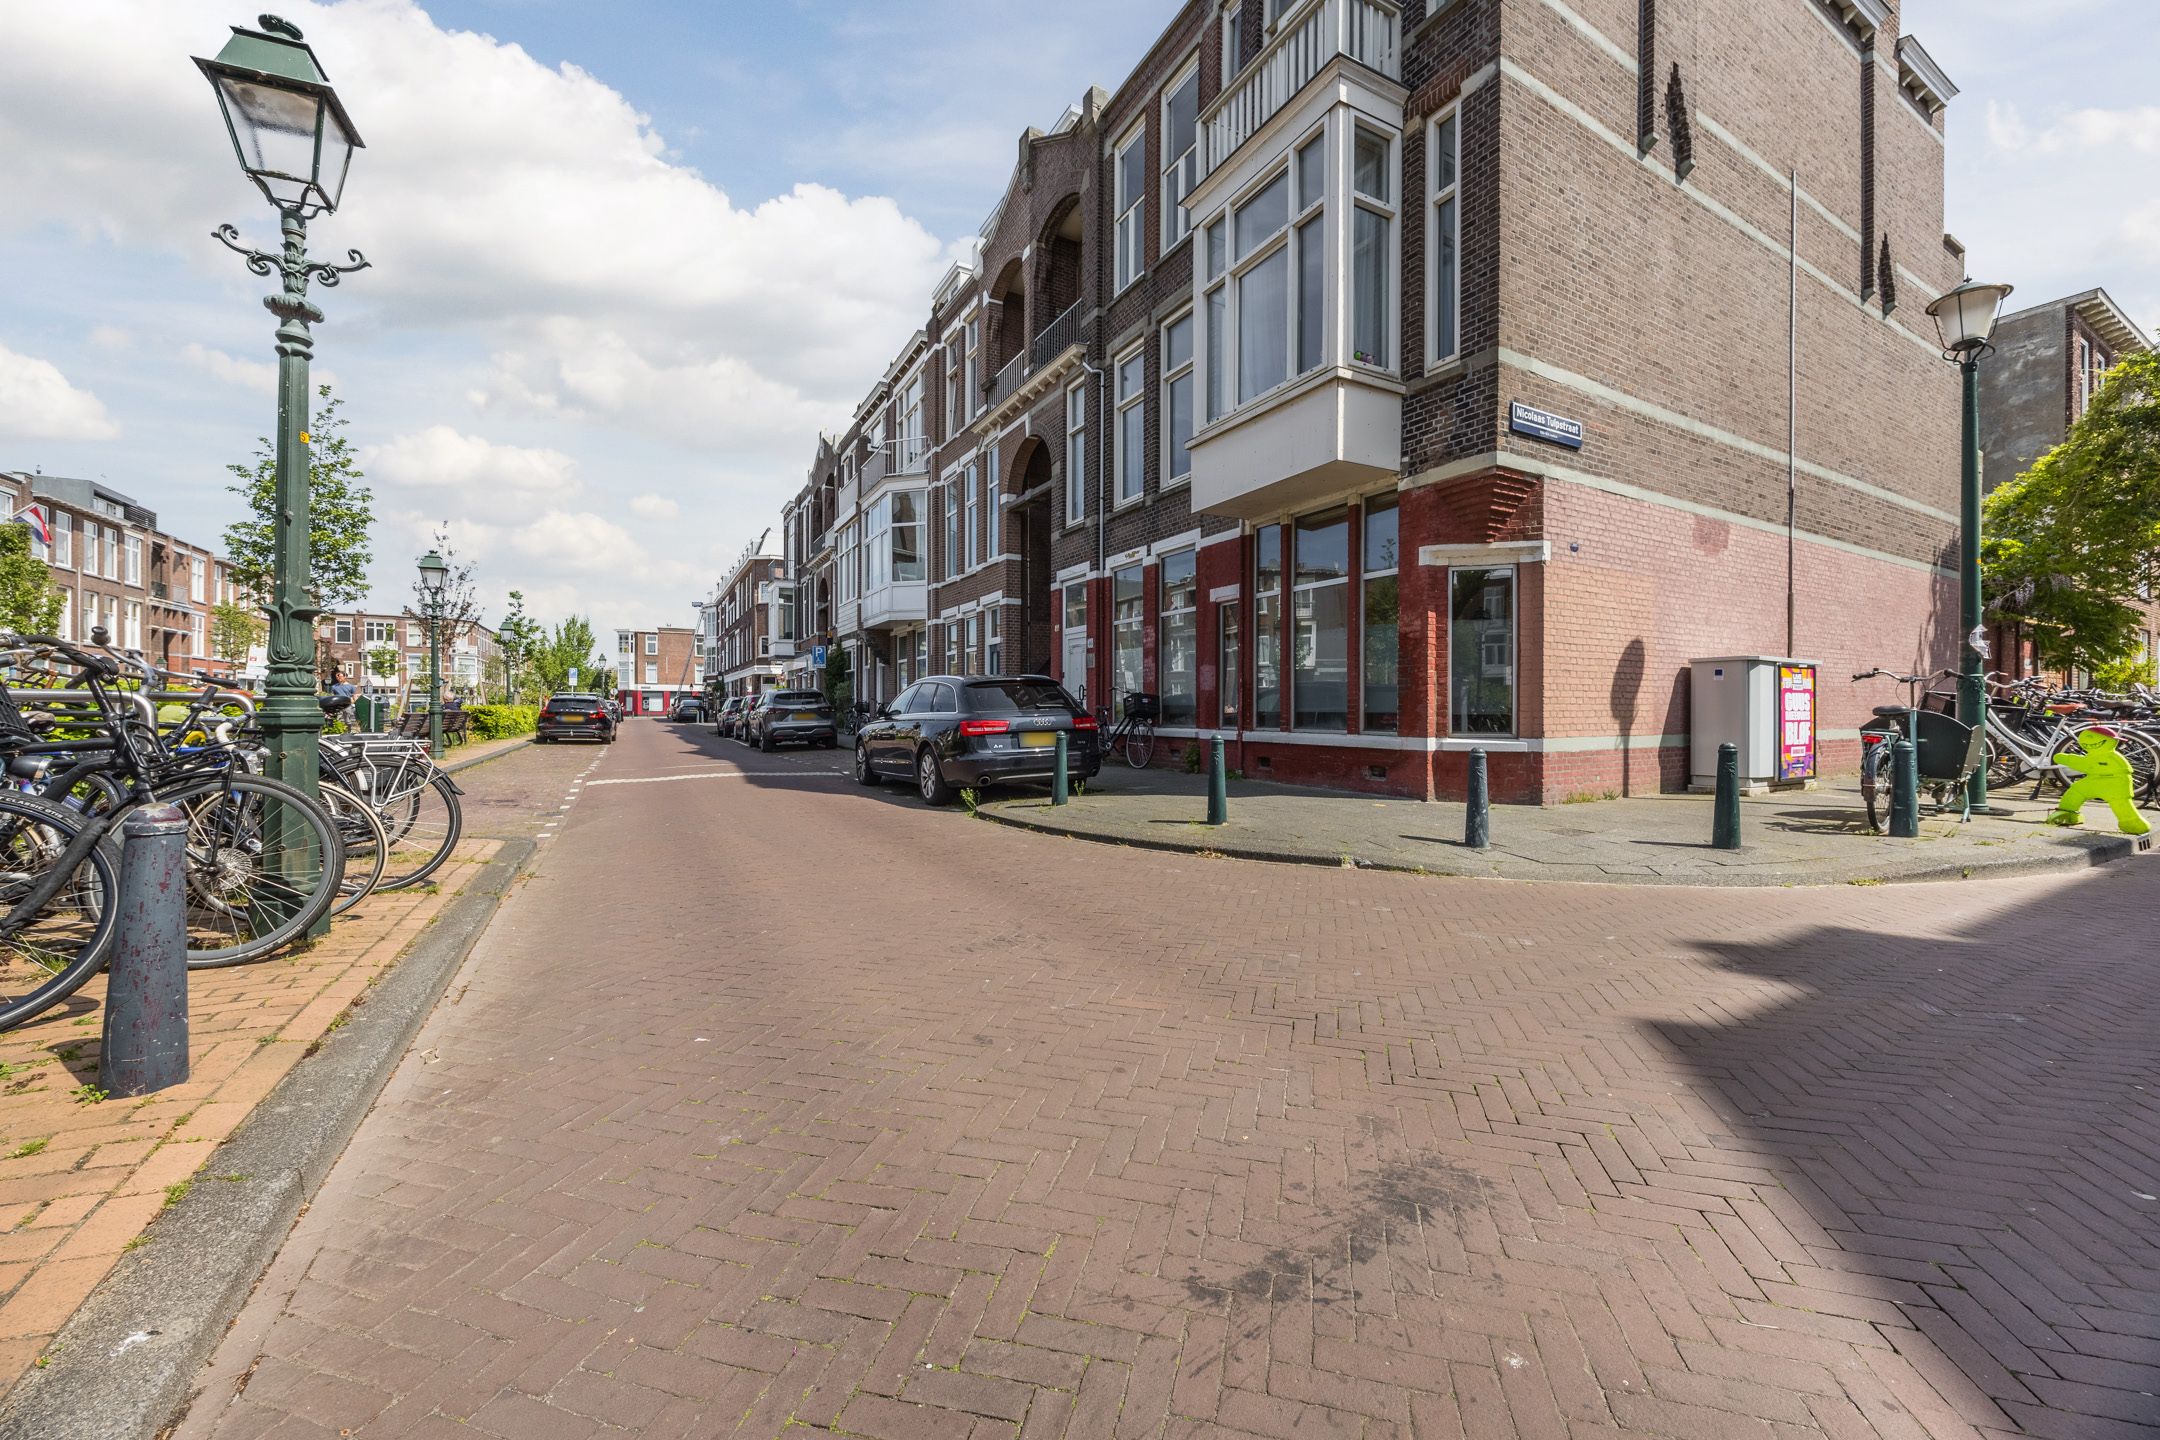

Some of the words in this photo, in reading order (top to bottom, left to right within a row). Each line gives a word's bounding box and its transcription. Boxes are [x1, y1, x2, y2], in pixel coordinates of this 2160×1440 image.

[1516, 406, 1545, 424] Nicolaas
[1546, 416, 1579, 435] Tulpstraat
[5, 797, 45, 811] CLASSIC
